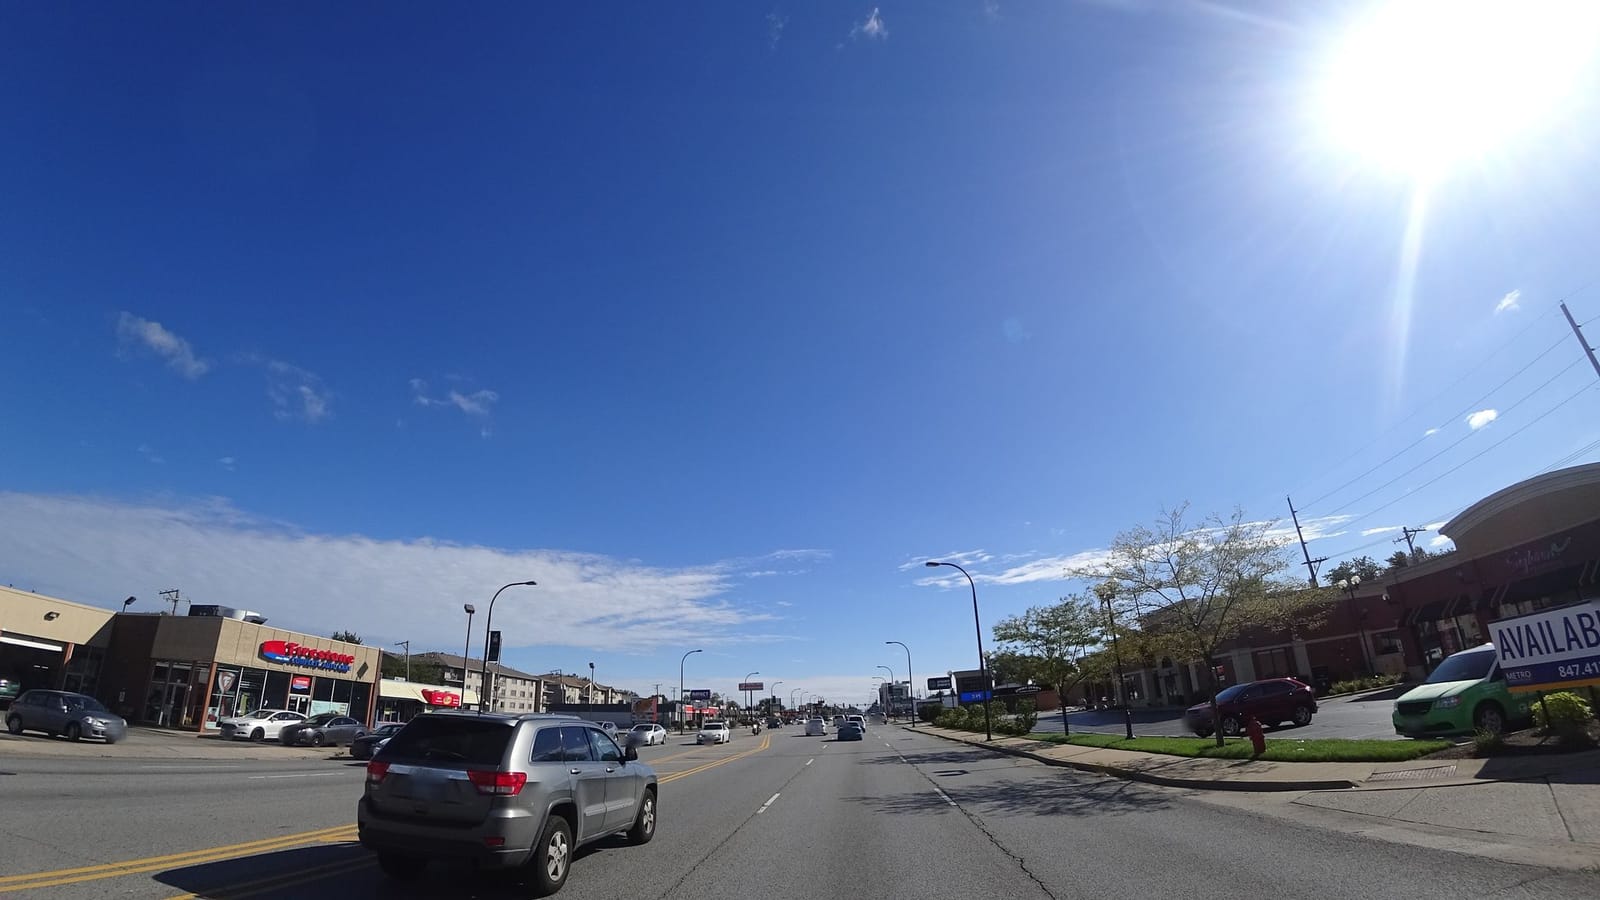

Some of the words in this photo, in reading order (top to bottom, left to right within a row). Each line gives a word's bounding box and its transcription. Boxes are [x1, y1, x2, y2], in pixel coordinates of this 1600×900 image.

[1498, 609, 1600, 661] AVAILAB
[285, 641, 355, 664] Firestone
[1506, 670, 1532, 680] METRO
[1558, 661, 1600, 678] 847.41
